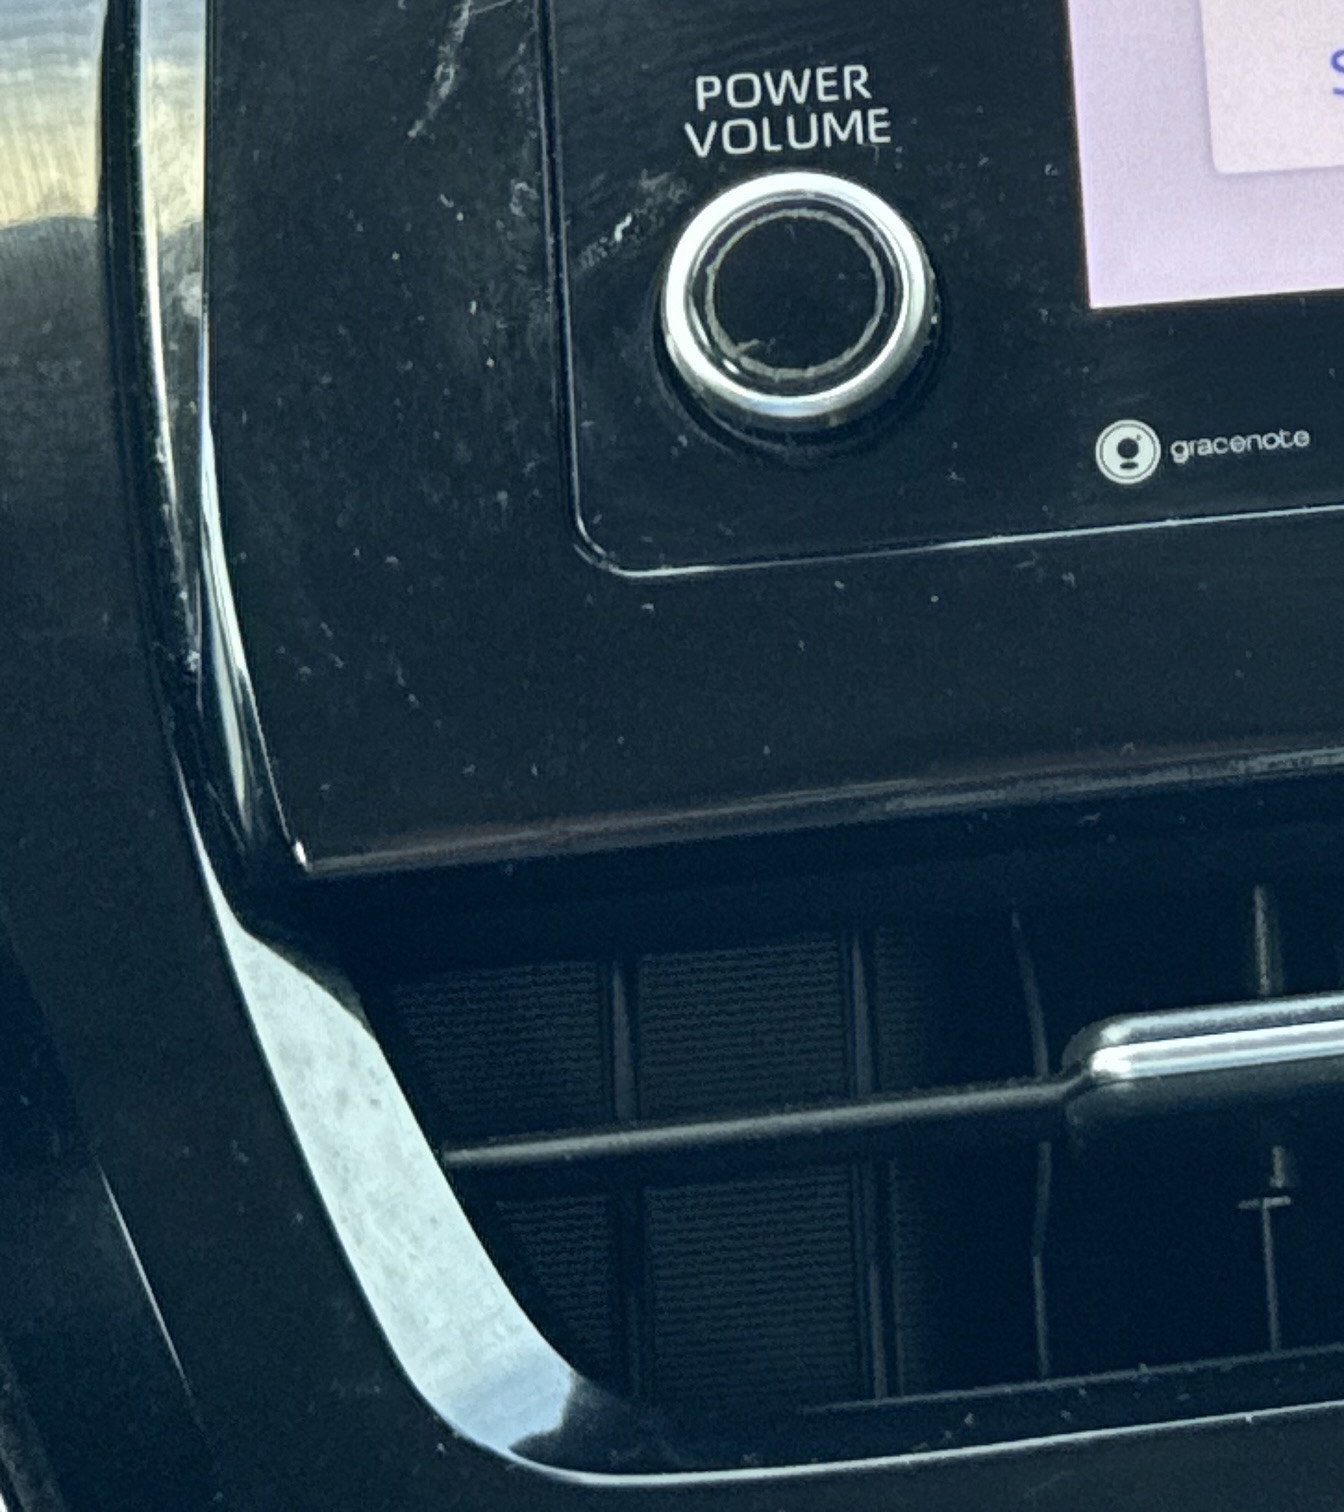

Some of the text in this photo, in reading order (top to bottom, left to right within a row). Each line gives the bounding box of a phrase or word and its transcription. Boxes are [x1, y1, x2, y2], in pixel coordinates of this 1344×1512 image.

[696, 64, 872, 111] POWER
[684, 108, 891, 158] VOLUME
[1170, 428, 1311, 464] gracenote
